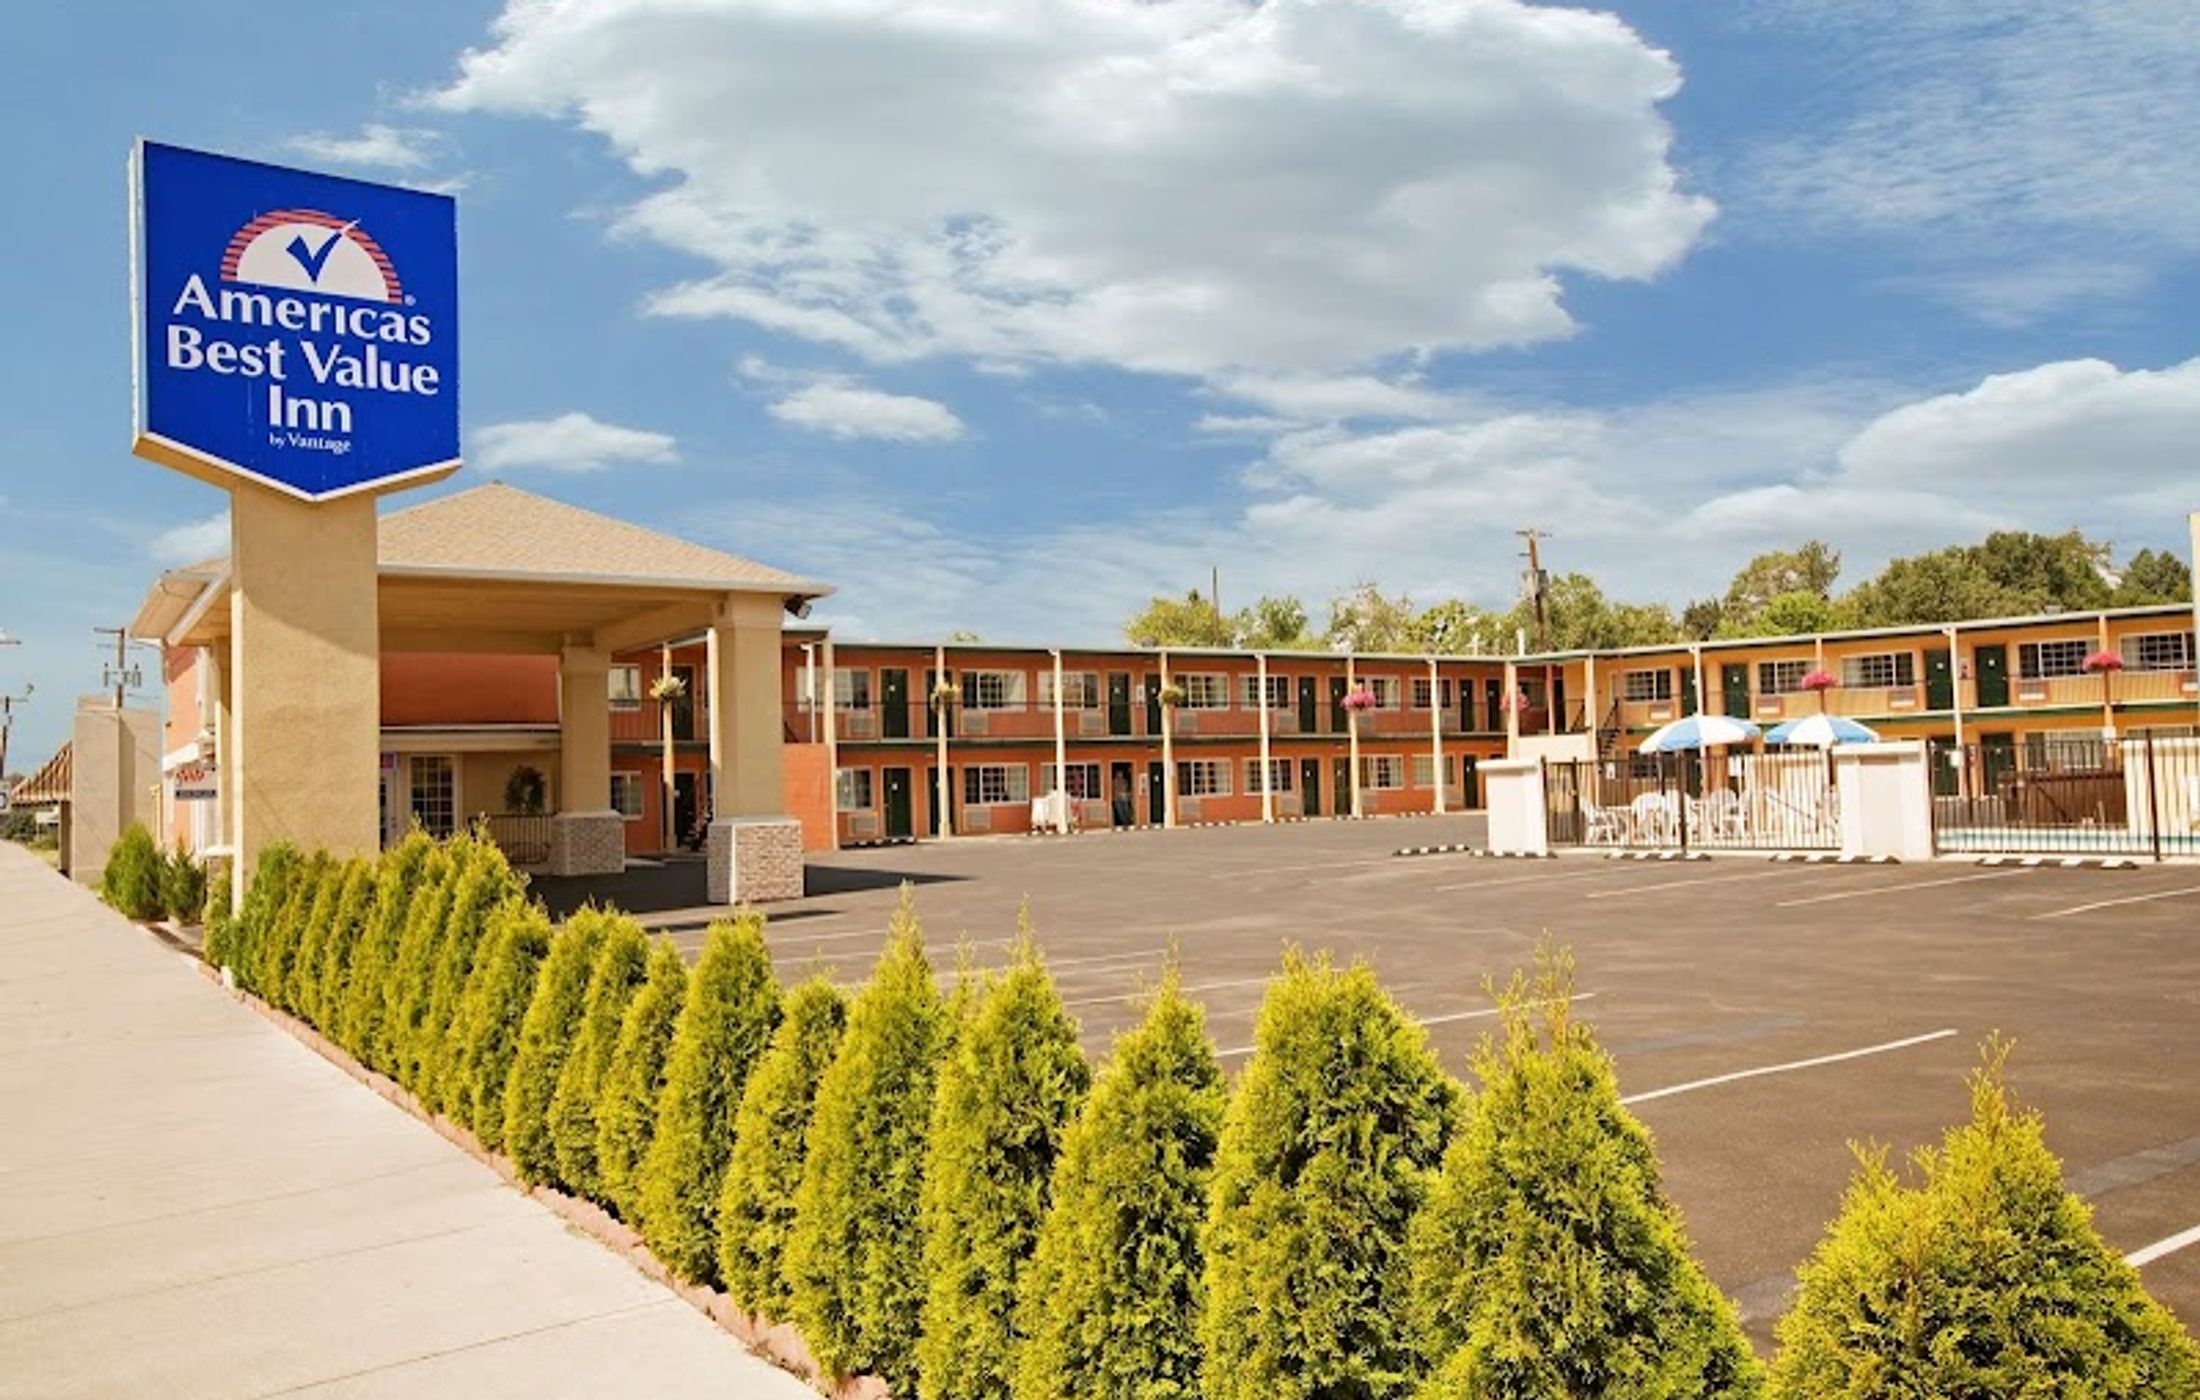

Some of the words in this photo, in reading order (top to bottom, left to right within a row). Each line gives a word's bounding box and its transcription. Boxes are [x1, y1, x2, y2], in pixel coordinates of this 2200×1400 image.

[173, 273, 431, 346] Americas
[167, 324, 287, 380] Best
[301, 341, 440, 395] Value
[269, 385, 352, 433] Inn
[269, 432, 285, 450] by
[286, 432, 351, 455] Vantage
